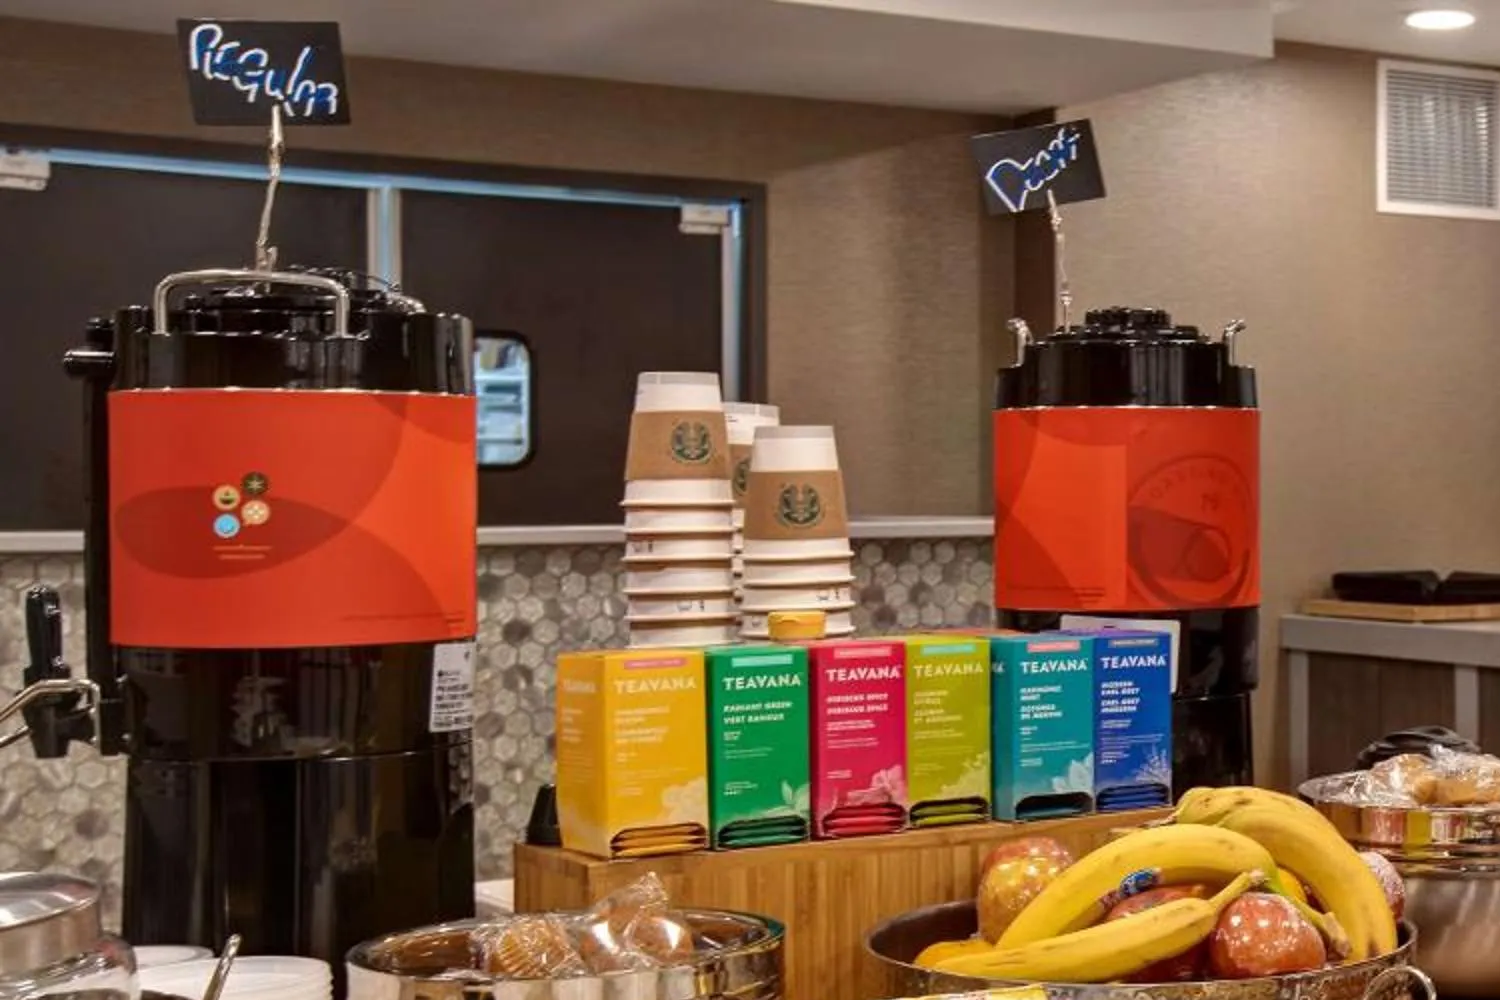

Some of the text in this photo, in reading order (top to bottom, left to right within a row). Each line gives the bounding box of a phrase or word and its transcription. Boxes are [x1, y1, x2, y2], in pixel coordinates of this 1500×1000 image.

[913, 661, 984, 678] TEAVANA
[1019, 658, 1088, 675] TEAVANA
[1100, 654, 1167, 670] TEAVANA
[721, 674, 802, 691] TEAVANA
[825, 666, 900, 683] TEAVANA
[613, 676, 698, 694] TEAVANA
